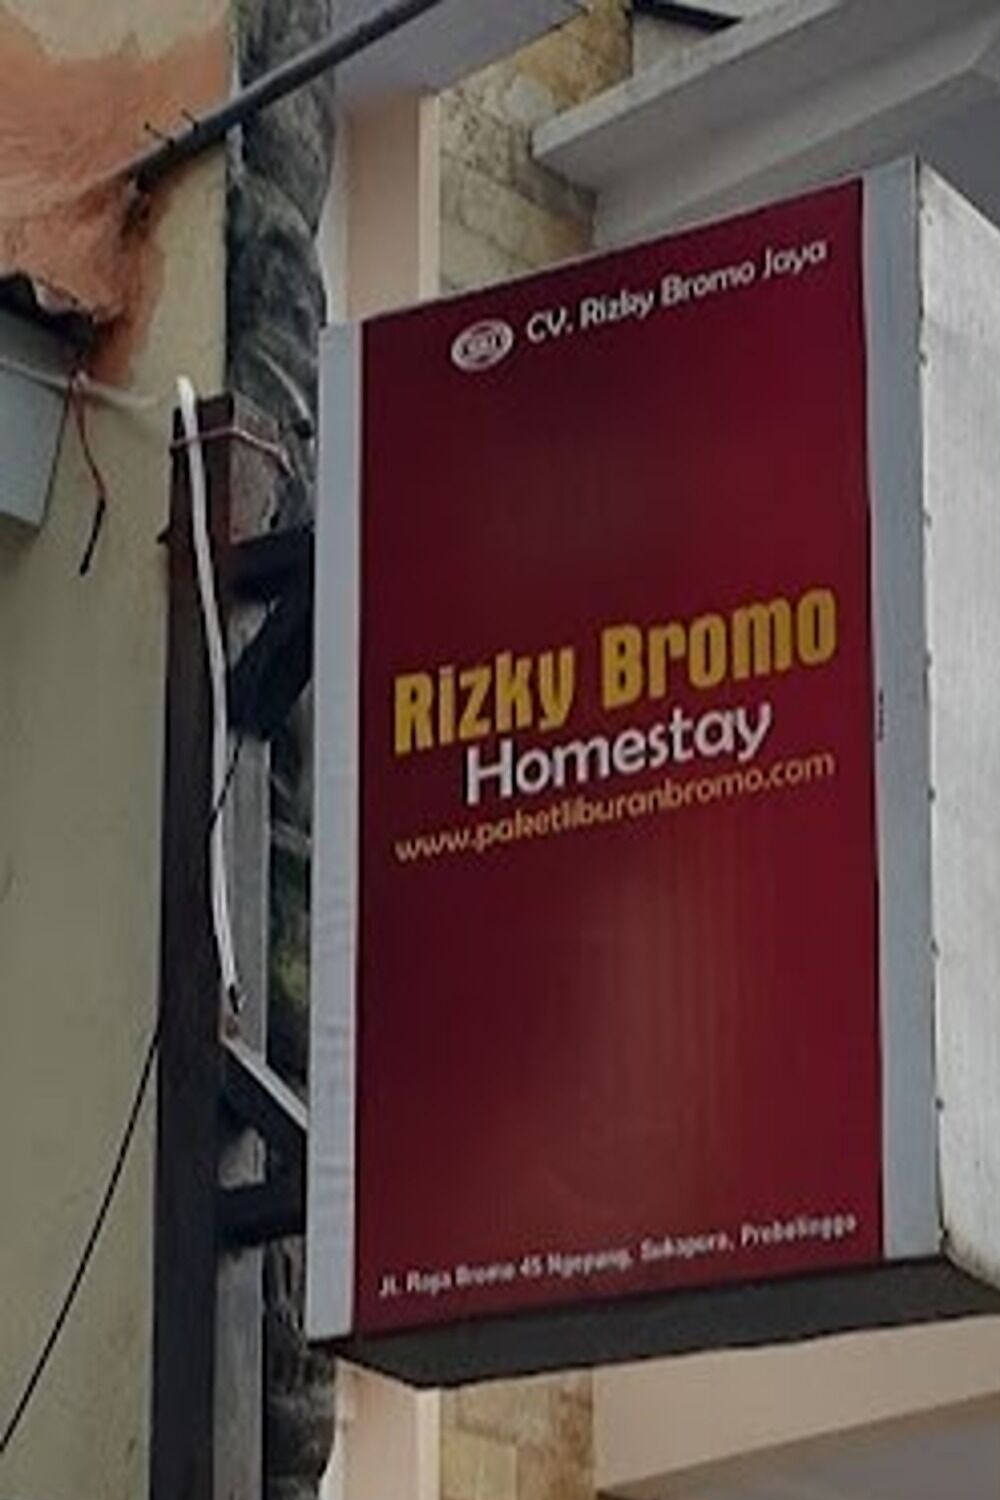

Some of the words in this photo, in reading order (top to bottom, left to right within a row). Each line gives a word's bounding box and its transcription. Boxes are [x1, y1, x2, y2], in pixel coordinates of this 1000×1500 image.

[526, 309, 575, 344] CV.
[579, 289, 656, 330] Rizky
[659, 259, 756, 305] Bromo
[763, 239, 828, 279] Jaya
[393, 646, 576, 755] Rizky
[602, 588, 837, 709] Bromo
[394, 751, 835, 862] www.paketliburanbromo.com
[465, 702, 773, 805] Homestay
